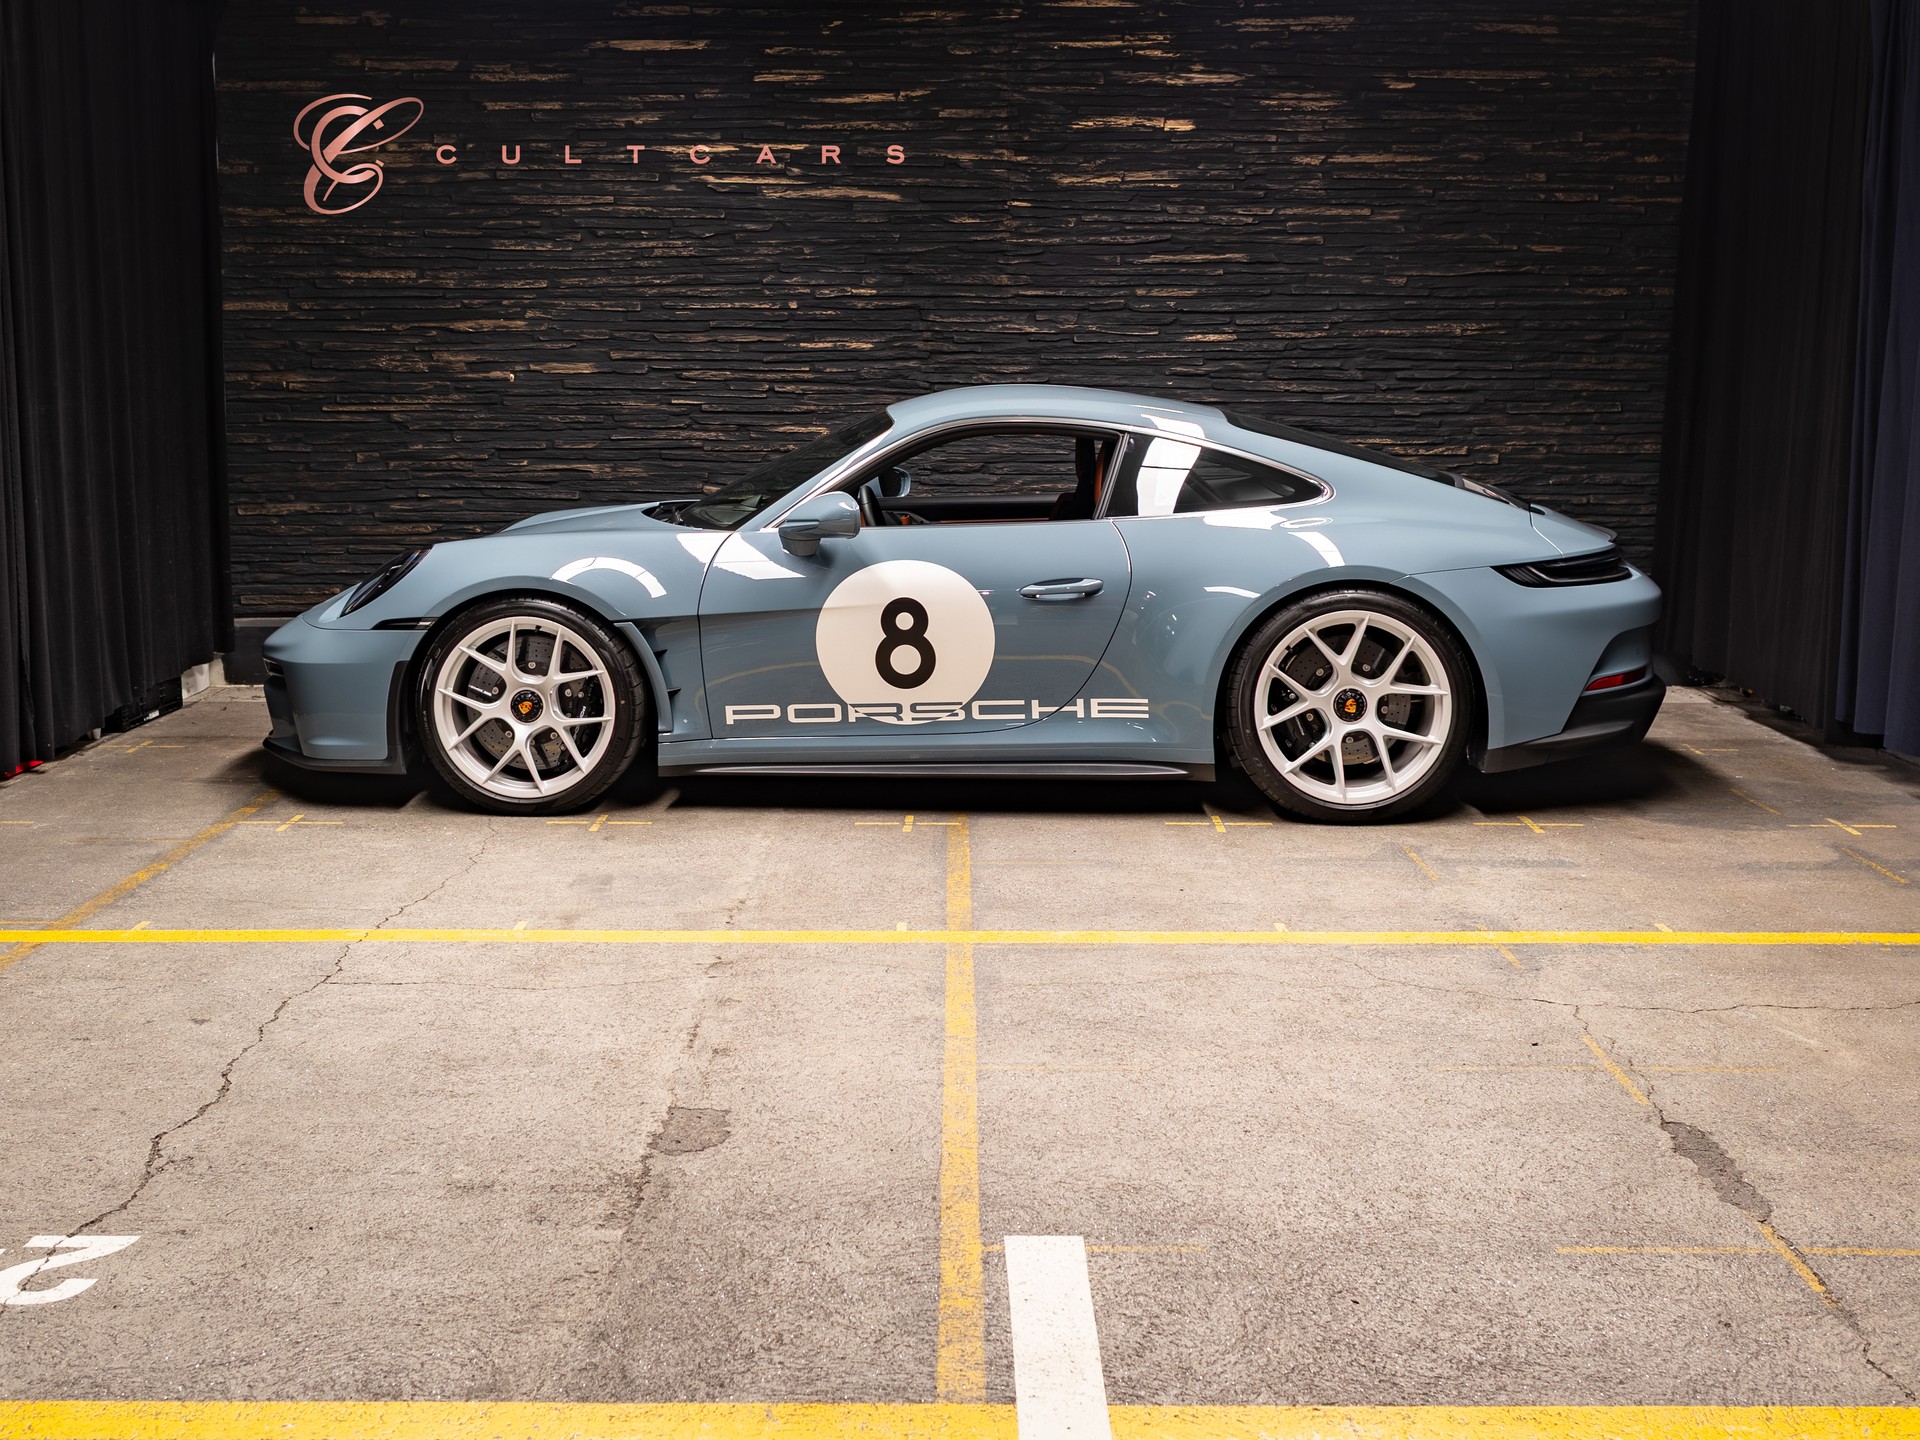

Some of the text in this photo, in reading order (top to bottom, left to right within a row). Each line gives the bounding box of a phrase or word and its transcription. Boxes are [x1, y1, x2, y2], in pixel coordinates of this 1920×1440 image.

[436, 144, 906, 165] CULTCARS
[875, 597, 937, 690] 8
[725, 698, 1150, 725] PORSCHE
